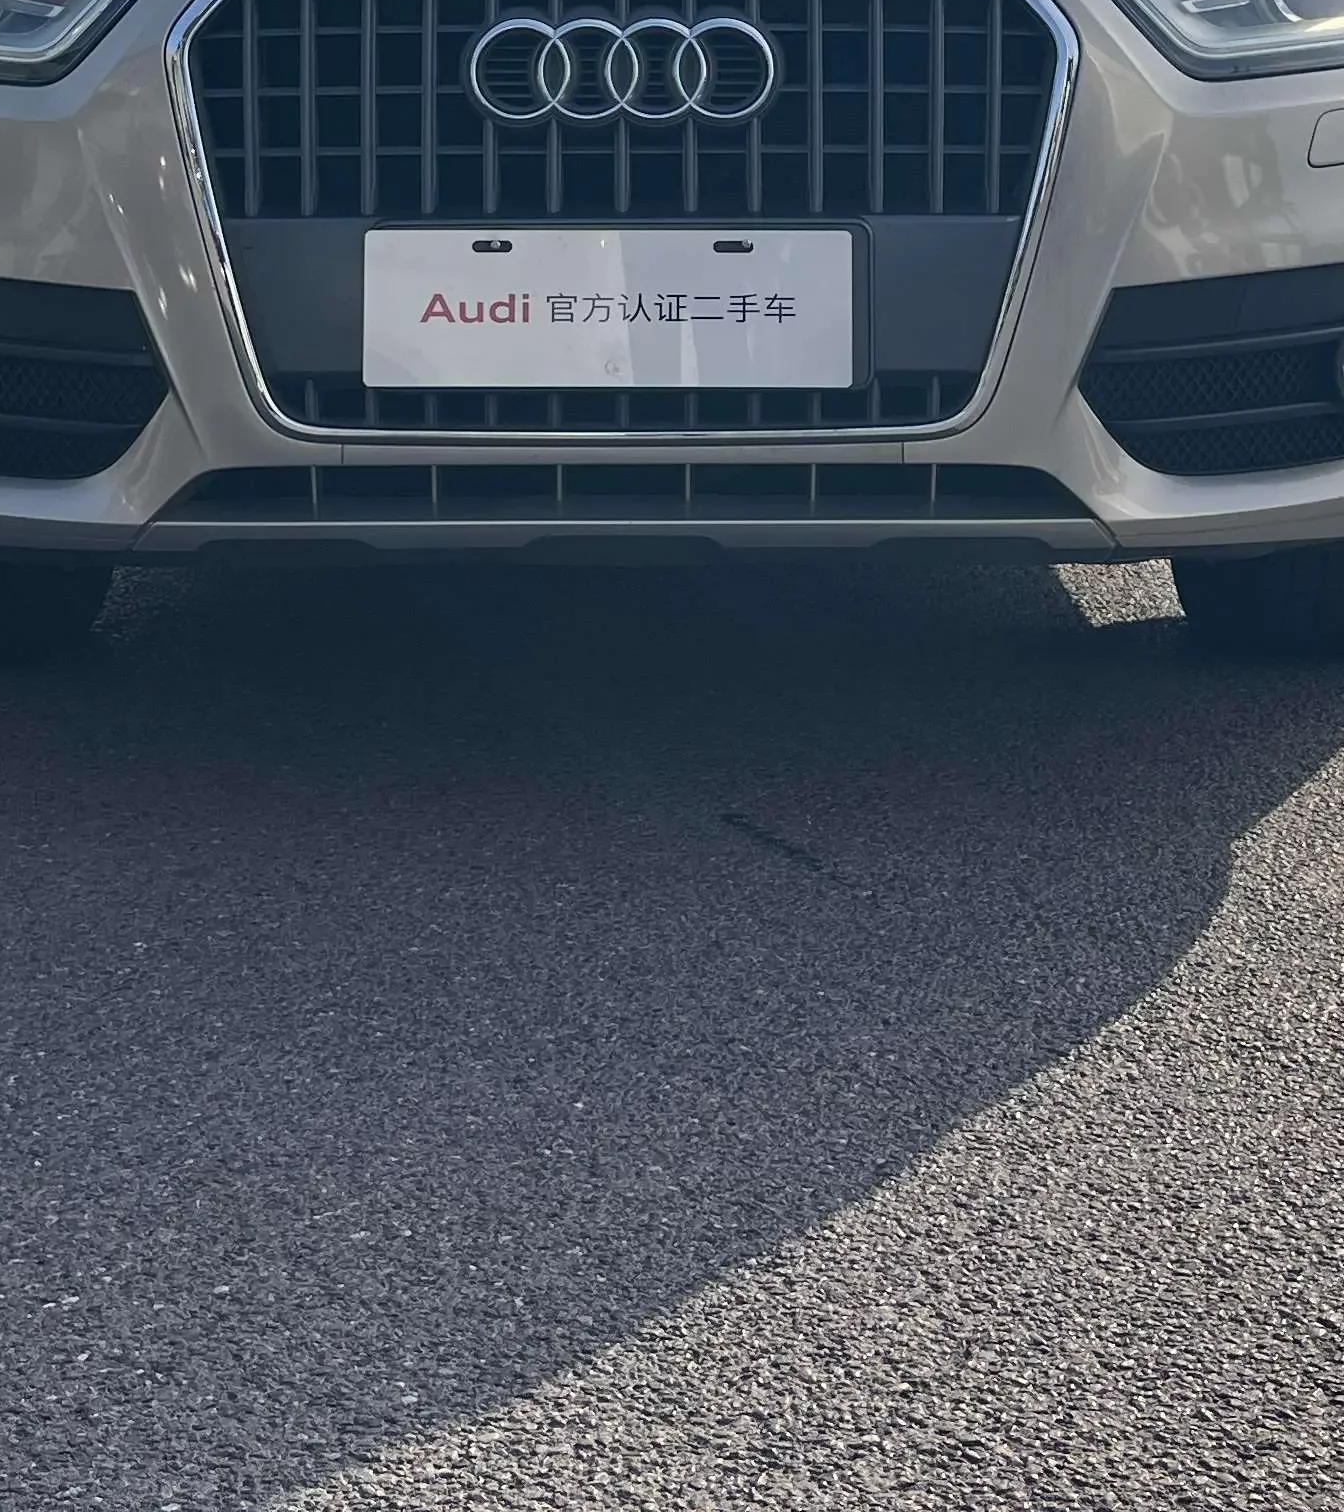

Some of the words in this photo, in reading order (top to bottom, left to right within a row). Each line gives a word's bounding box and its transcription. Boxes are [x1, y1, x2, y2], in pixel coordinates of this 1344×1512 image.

[419, 292, 531, 324] Audi
[545, 292, 797, 324] 官方认证二手车
